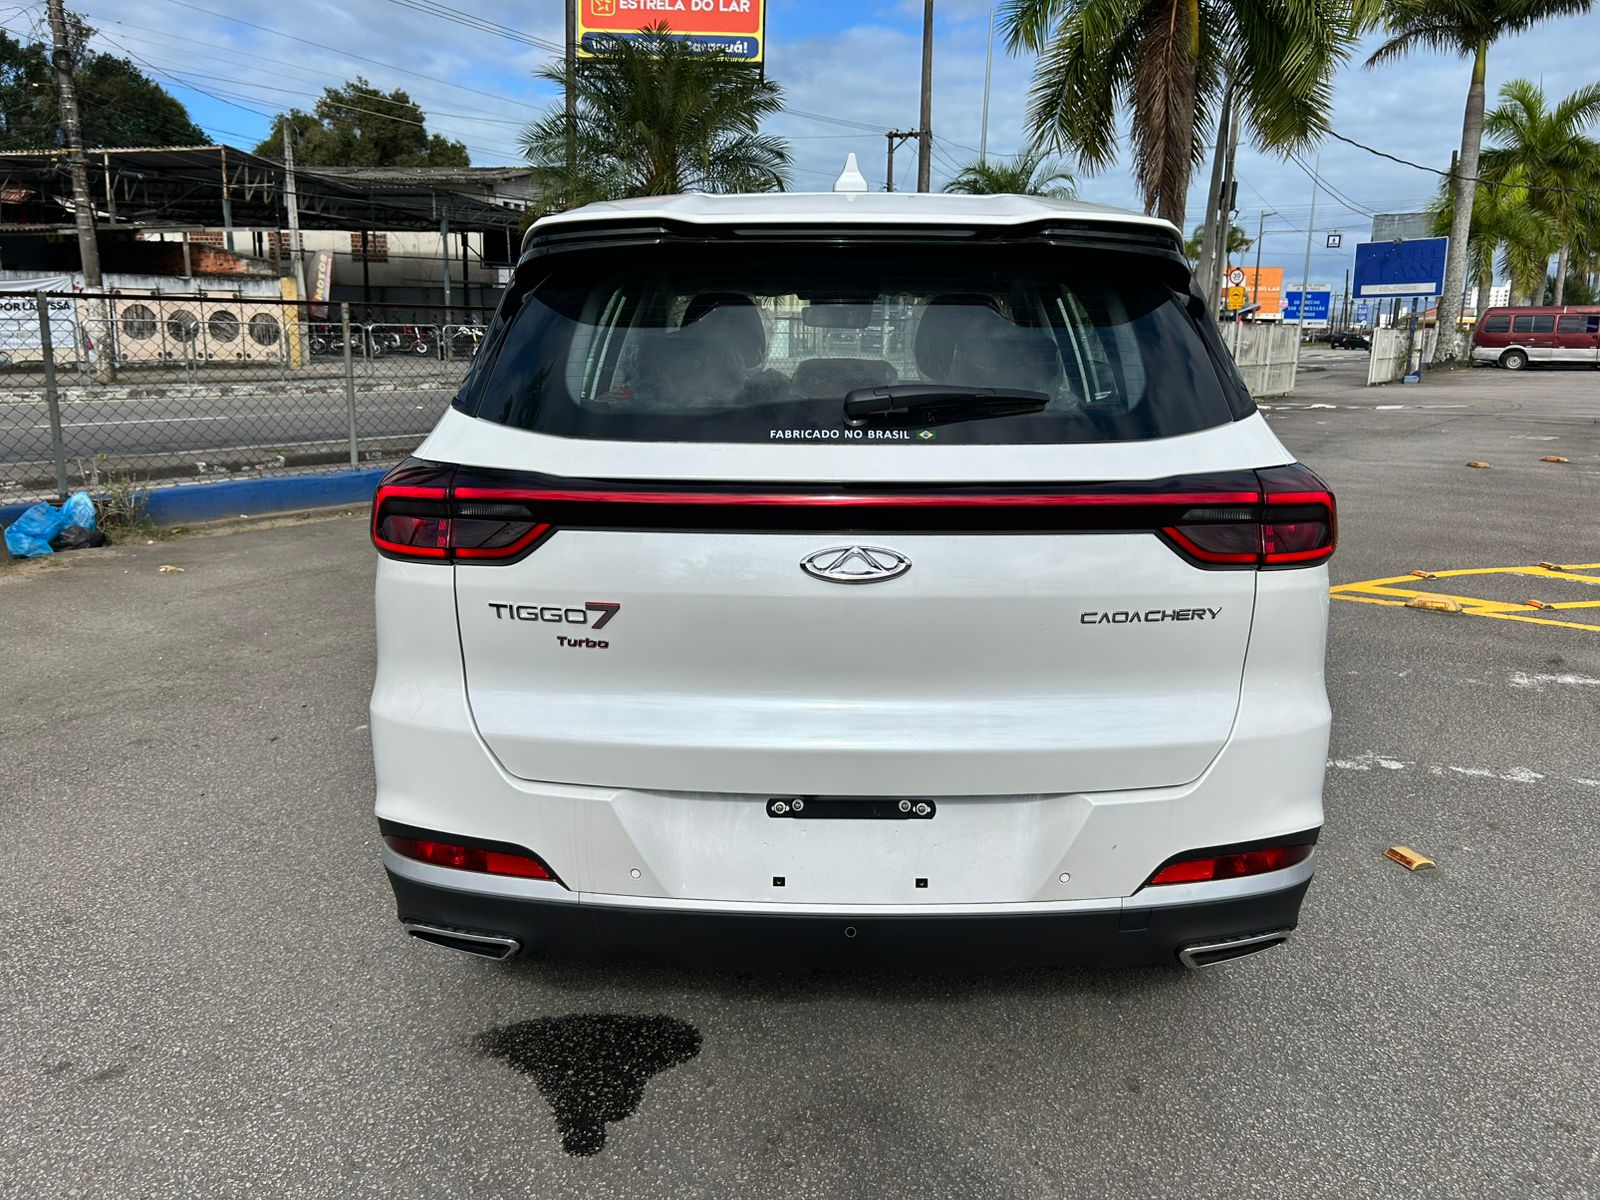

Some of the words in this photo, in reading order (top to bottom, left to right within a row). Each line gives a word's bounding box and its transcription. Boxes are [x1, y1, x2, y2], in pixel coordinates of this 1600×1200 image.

[619, 0, 685, 11] ESTRELA
[691, 0, 713, 11] DO
[719, 0, 750, 13] LAR
[770, 429, 840, 440] FABRICADO
[844, 429, 863, 440] NO
[868, 429, 910, 440] BRASIL
[557, 635, 610, 649] Turbo
